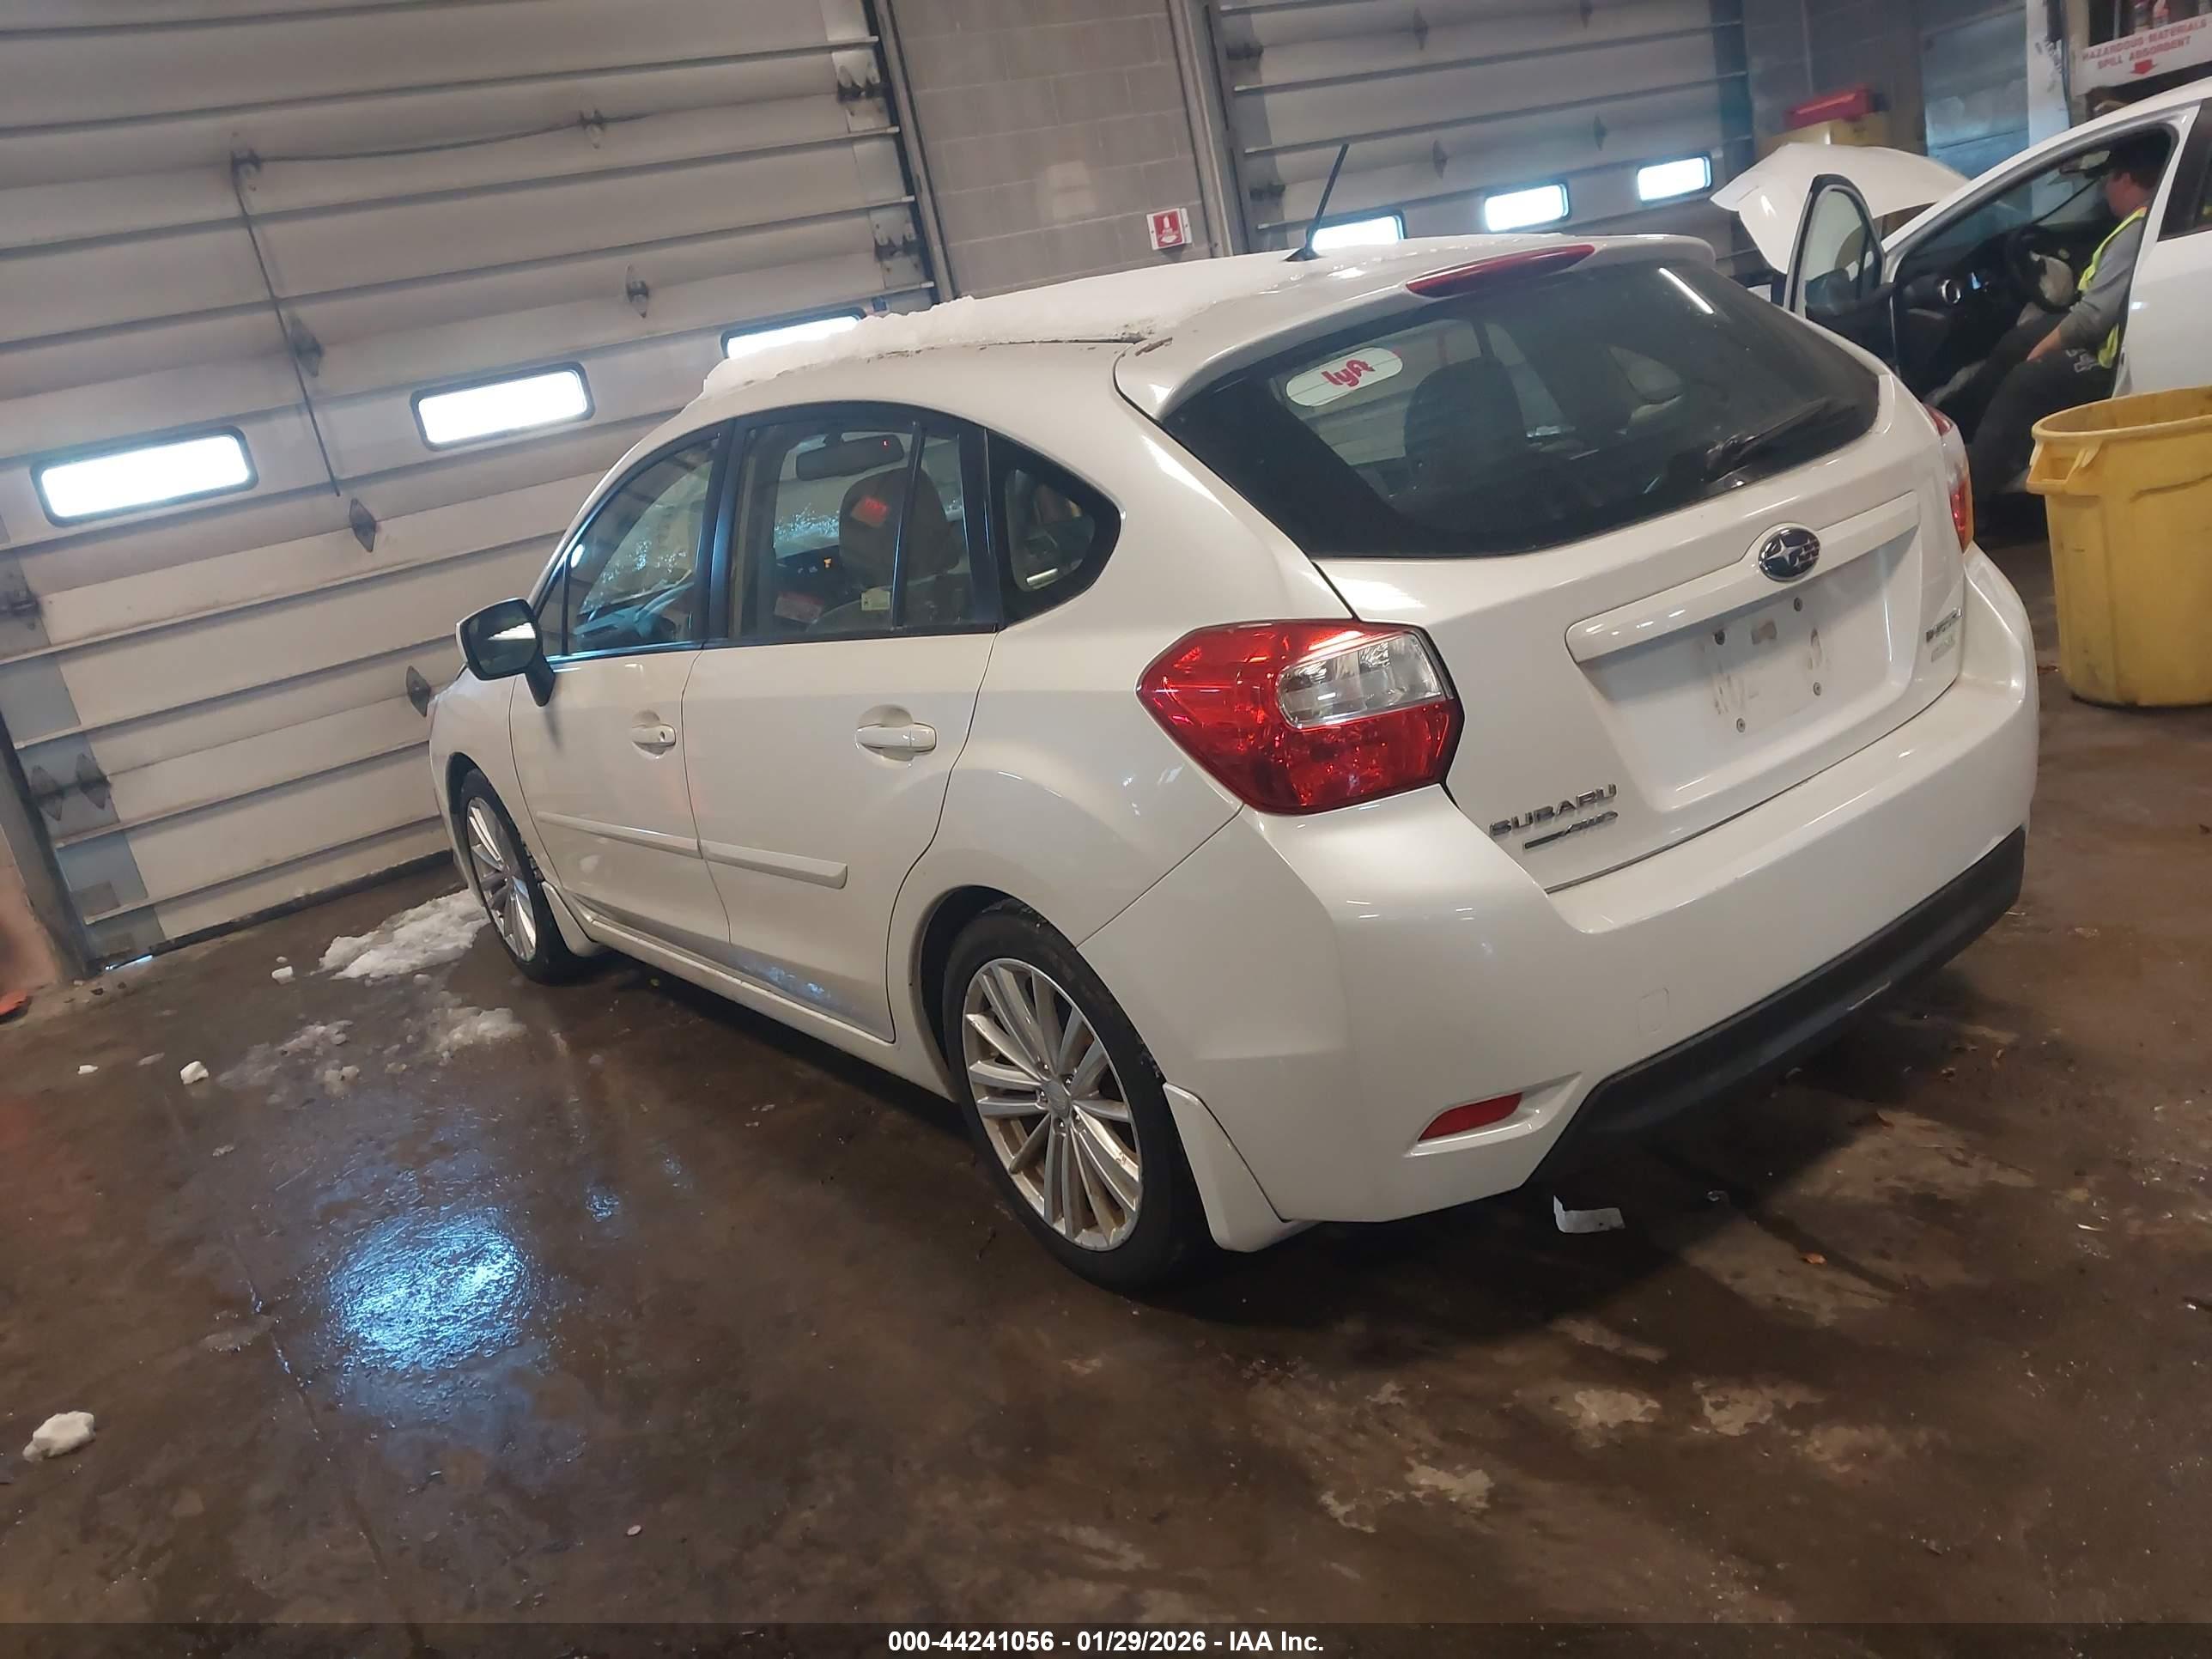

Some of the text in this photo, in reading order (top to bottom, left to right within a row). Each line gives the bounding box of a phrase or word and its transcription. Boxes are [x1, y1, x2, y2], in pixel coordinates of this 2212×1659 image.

[2081, 37, 2144, 60] HAZARDOUS
[2148, 19, 2207, 42] MATERIALS
[2097, 36, 2191, 69] SPILL ABSORBENT
[1490, 783, 1617, 836] SUBARU
